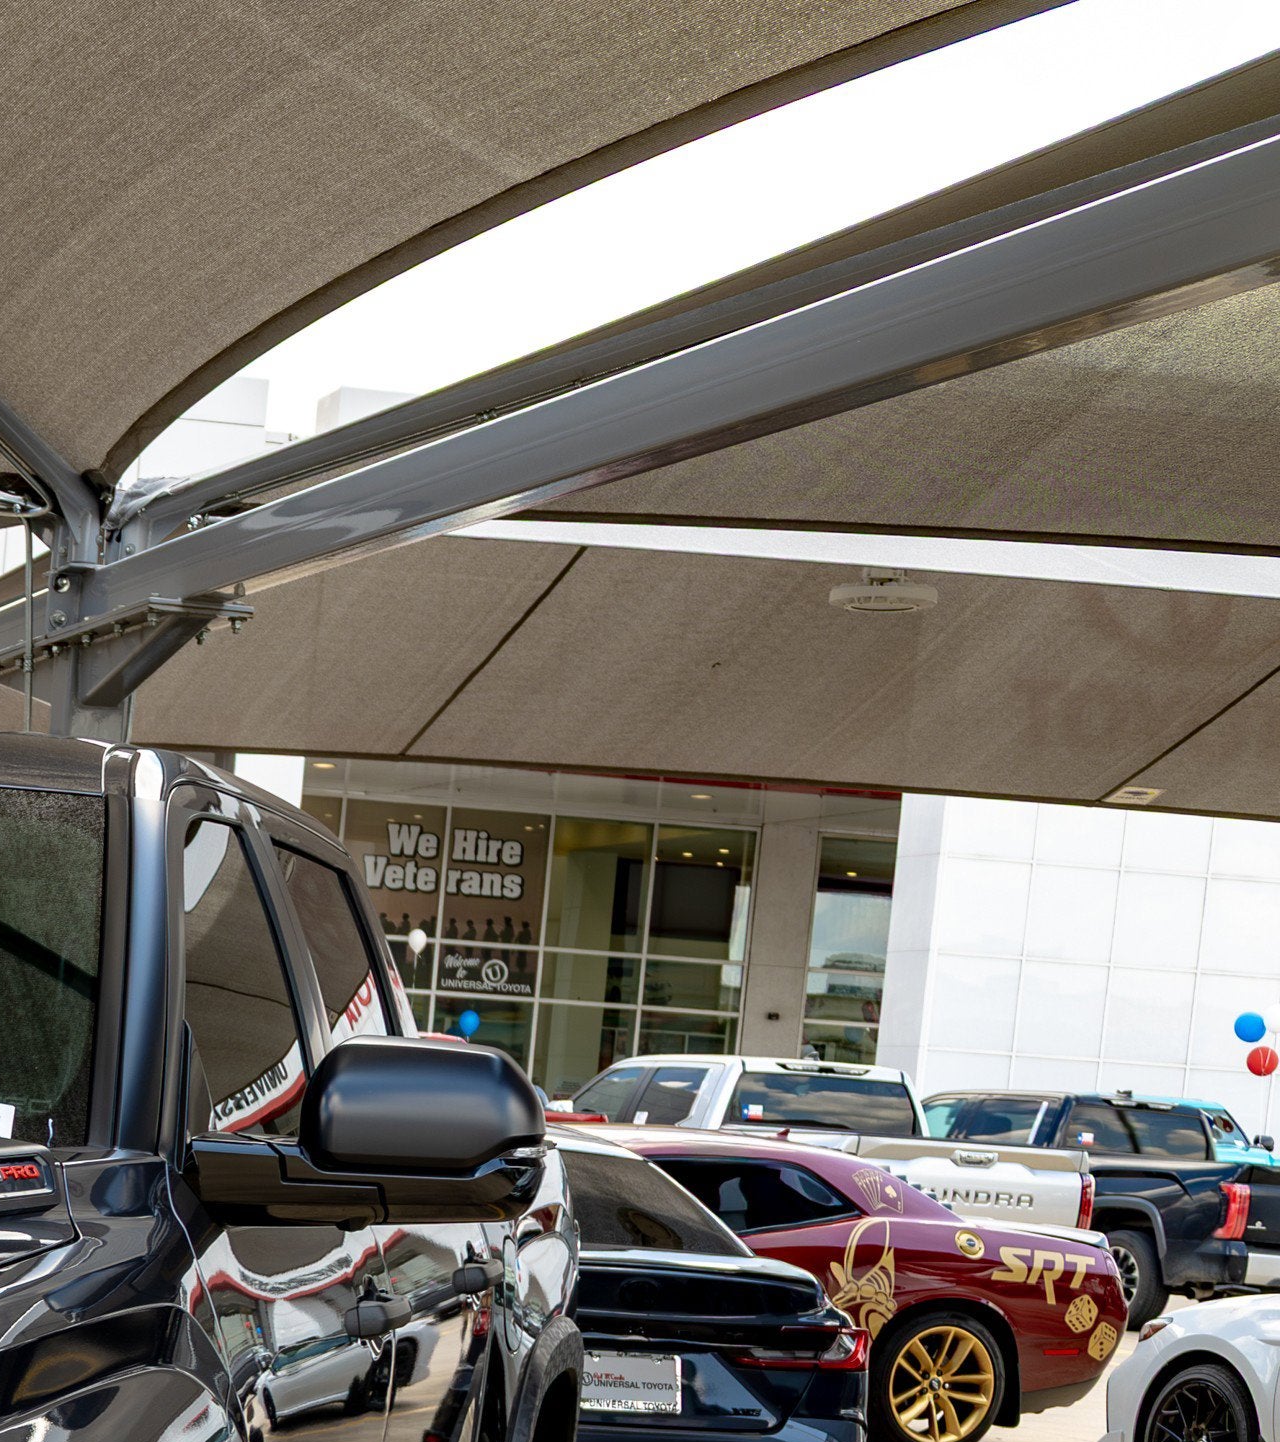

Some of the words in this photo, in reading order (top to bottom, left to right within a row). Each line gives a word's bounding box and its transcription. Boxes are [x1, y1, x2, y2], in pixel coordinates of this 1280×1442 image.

[386, 823, 439, 859] We
[451, 828, 524, 867] Hire
[363, 854, 525, 900] Veterans
[441, 978, 494, 991] UNIVERSAL
[496, 982, 532, 994] TOYOTA
[0, 1164, 40, 1181] PRO
[929, 1188, 1034, 1209] UNDRA
[991, 1246, 1096, 1306] SRT
[594, 1380, 640, 1389] UNIVERSAL
[641, 1382, 674, 1390] TOYOTA
[589, 1398, 640, 1410] UNIVERSAL
[643, 1401, 679, 1412] TOYOTA
